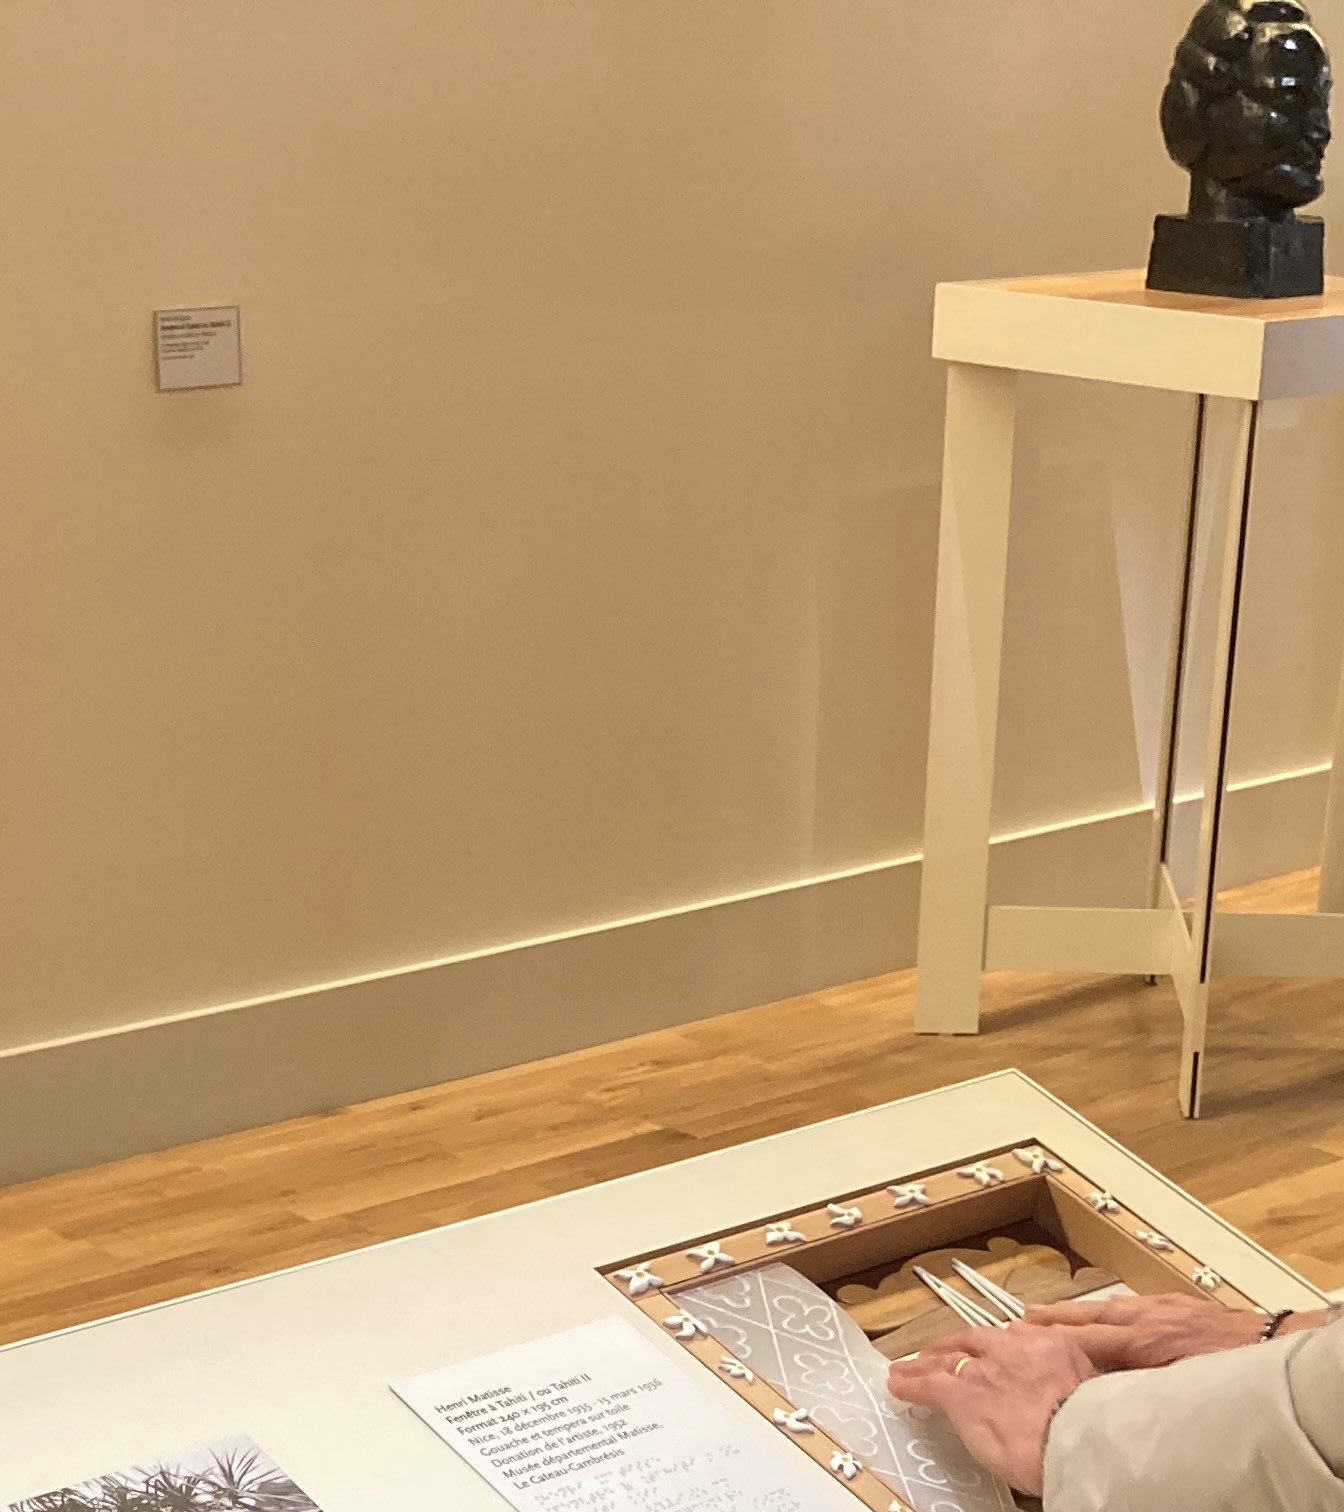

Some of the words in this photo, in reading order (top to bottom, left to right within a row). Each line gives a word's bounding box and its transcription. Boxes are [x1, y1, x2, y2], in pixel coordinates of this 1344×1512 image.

[434, 1398, 469, 1414] Henri
[466, 1386, 512, 1404] Matisse
[445, 1407, 489, 1425] Fenêtre
[487, 1403, 498, 1412] à
[495, 1393, 528, 1409] Tahiti
[536, 1388, 552, 1397] ou
[549, 1376, 583, 1391] Tahiti
[580, 1373, 592, 1382] II
[479, 1437, 530, 1457] Gouache
[530, 1432, 543, 1441] et
[541, 1418, 588, 1437] tempera
[587, 1411, 605, 1423] sur
[604, 1403, 631, 1416] toile
